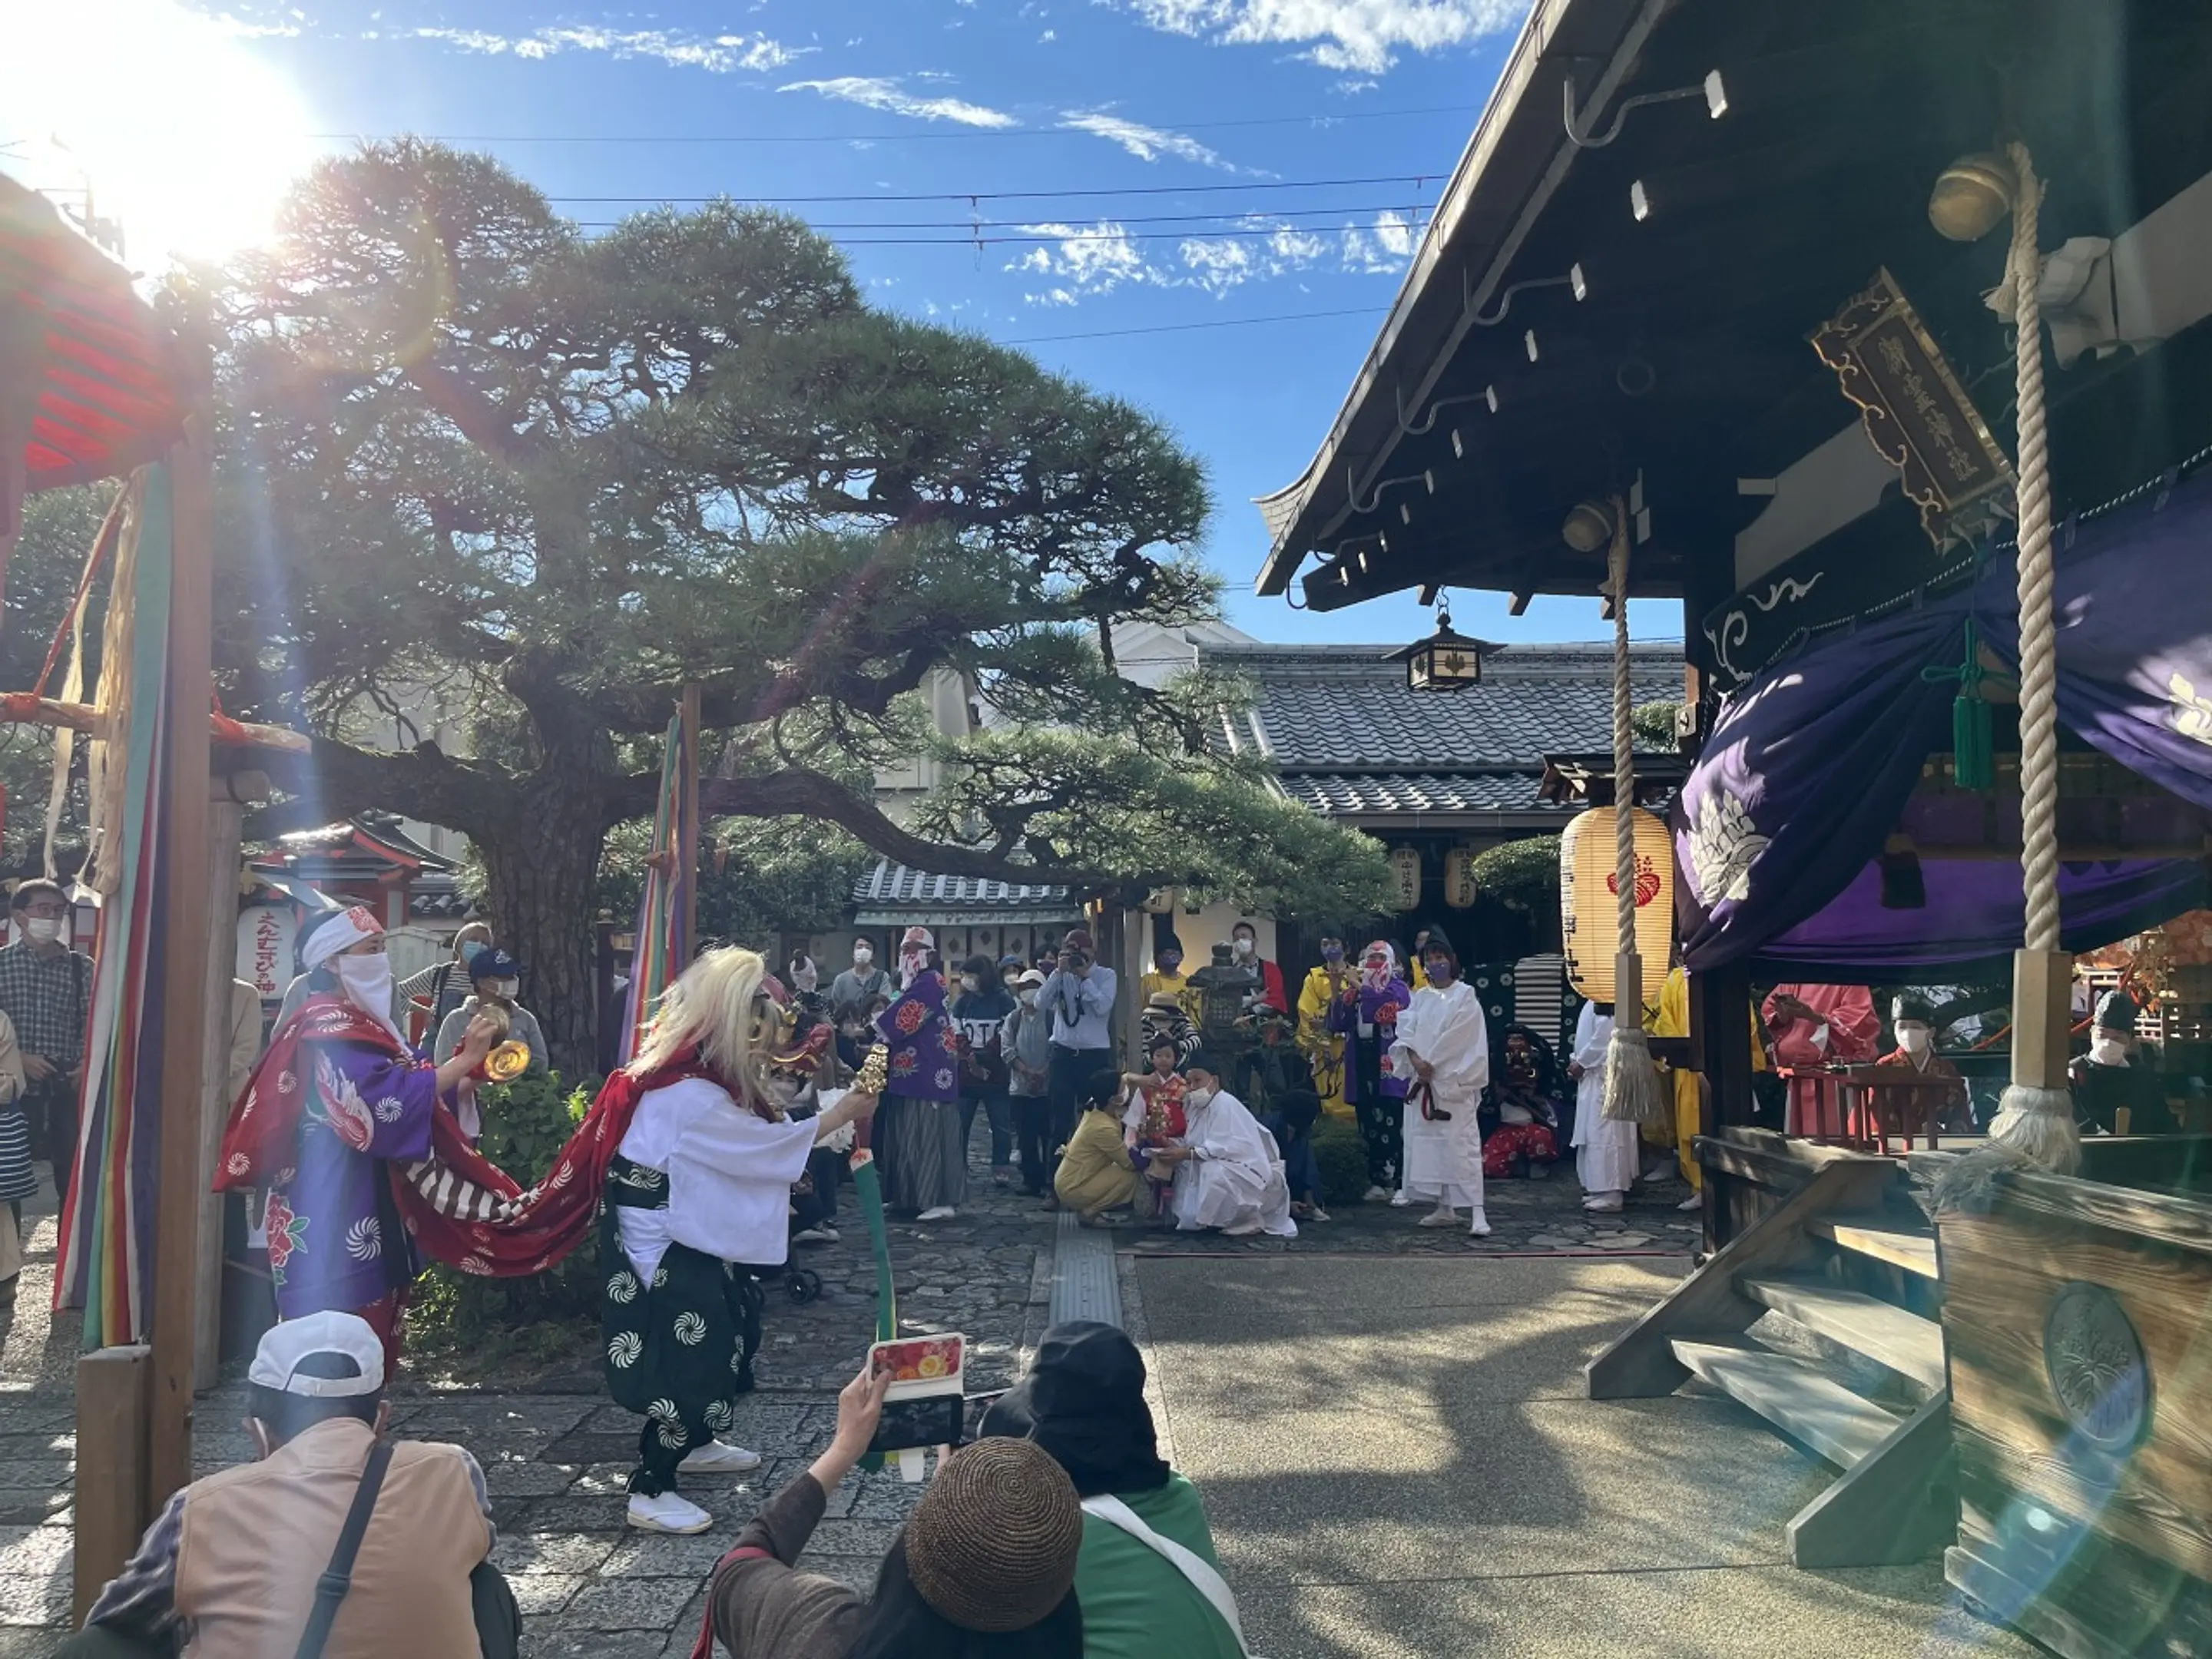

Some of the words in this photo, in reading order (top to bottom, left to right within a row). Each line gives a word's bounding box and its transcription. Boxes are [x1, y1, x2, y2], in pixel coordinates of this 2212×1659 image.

[255, 912, 282, 994] えんむすびの神
